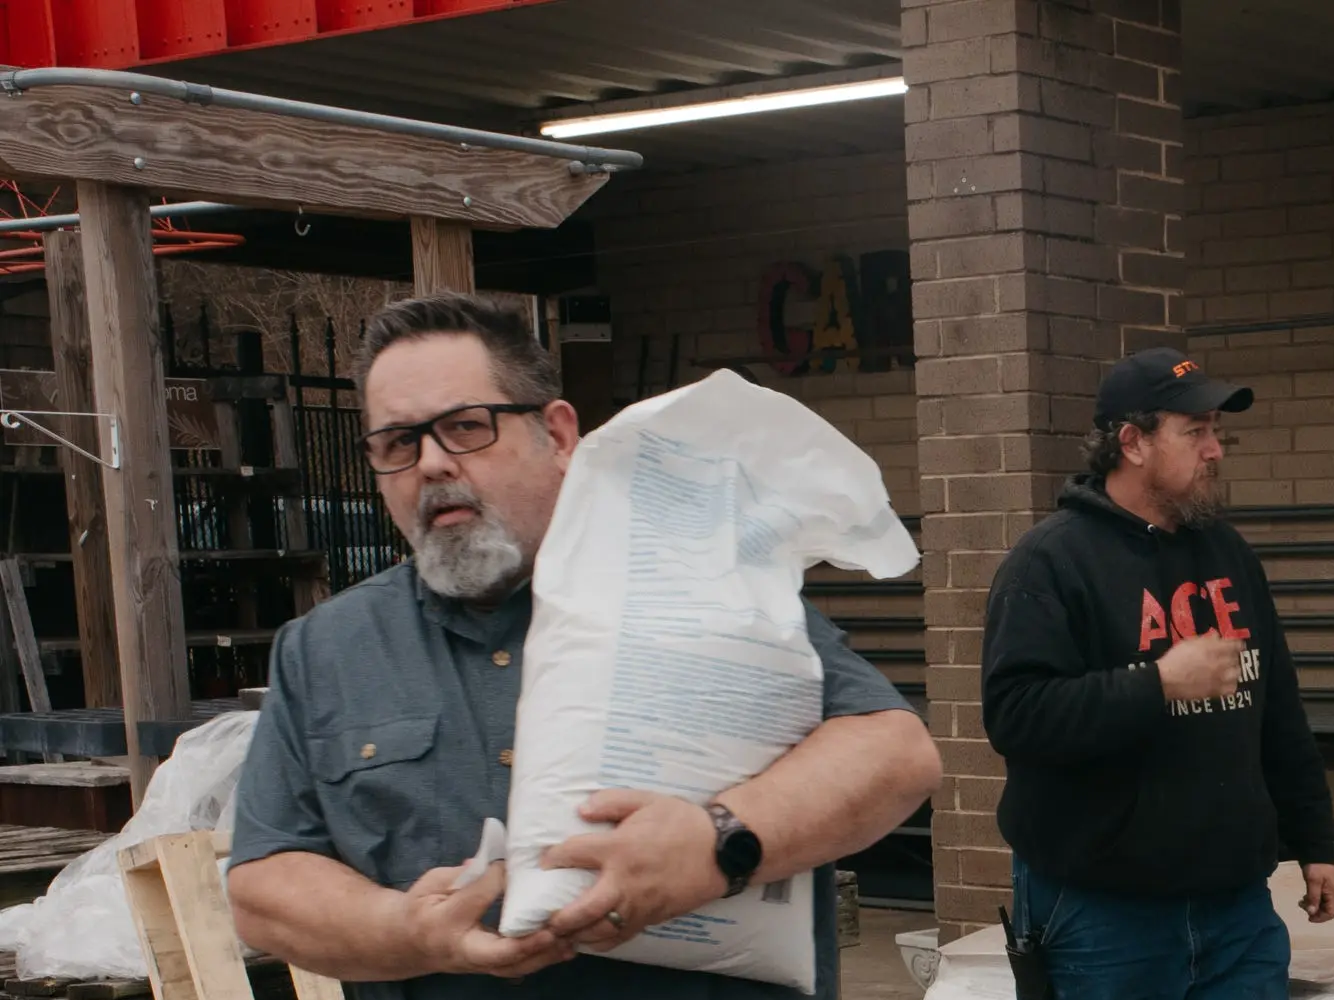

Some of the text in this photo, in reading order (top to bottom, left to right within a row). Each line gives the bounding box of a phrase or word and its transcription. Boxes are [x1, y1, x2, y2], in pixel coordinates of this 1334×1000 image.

[1138, 578, 1251, 651] ACE
[1171, 690, 1252, 716] INCE 1924
